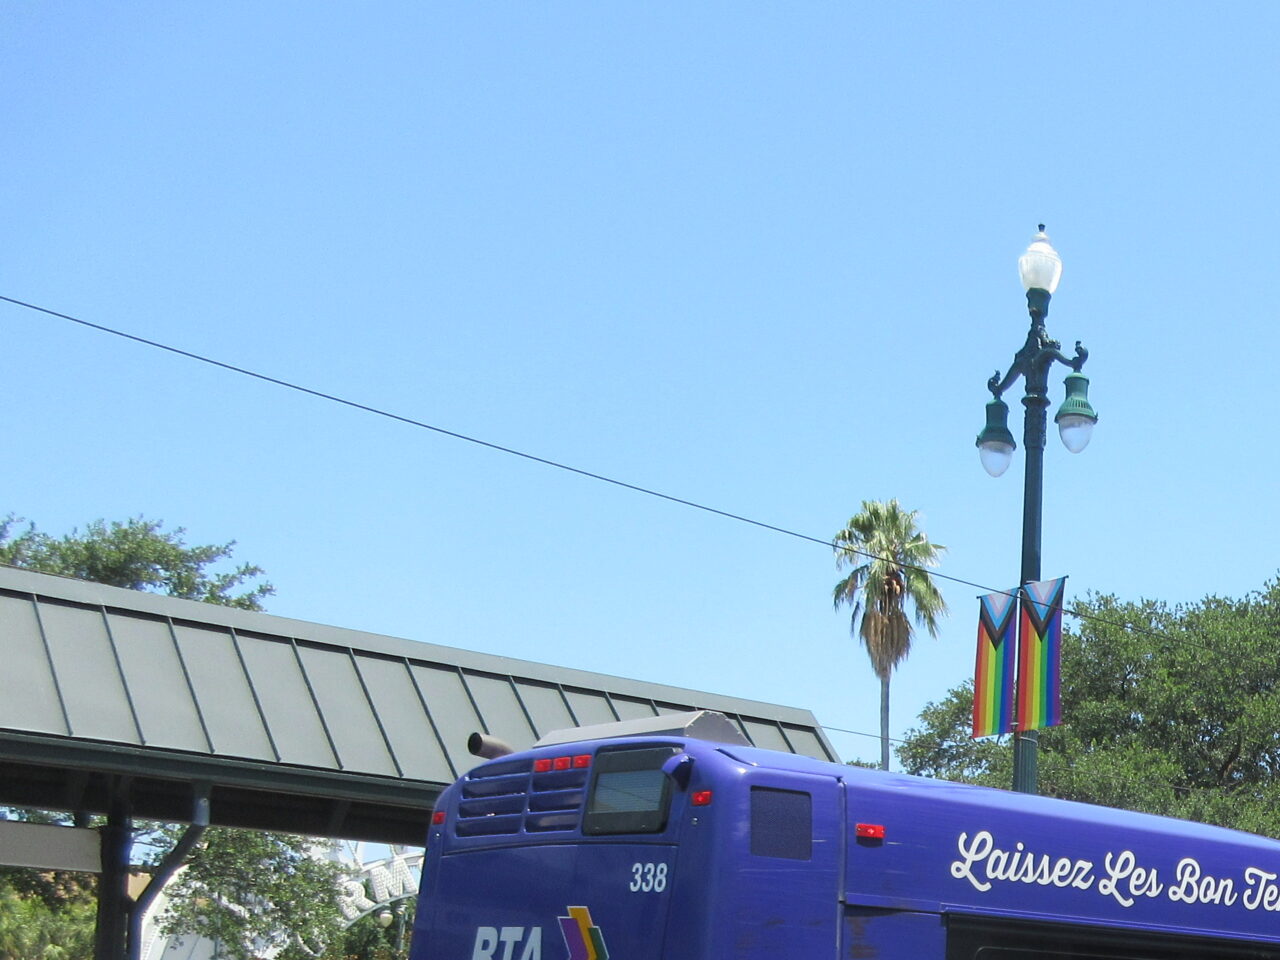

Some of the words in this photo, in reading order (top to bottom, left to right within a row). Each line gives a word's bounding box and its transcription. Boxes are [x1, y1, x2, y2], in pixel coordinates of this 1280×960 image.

[629, 862, 668, 893] 338
[950, 830, 1096, 892] Laissez
[1098, 850, 1164, 908] Les
[1168, 857, 1238, 907] Bon
